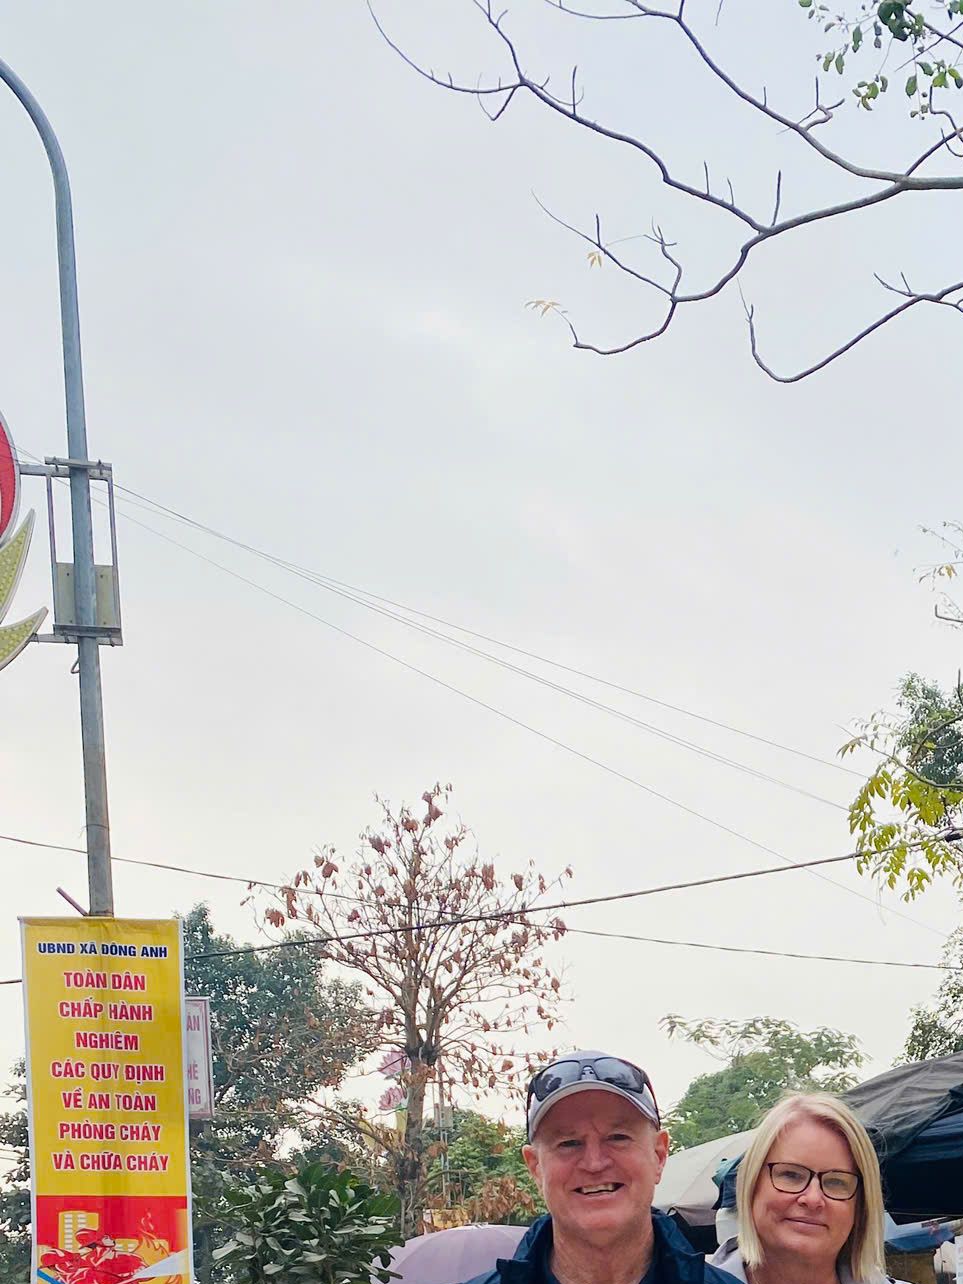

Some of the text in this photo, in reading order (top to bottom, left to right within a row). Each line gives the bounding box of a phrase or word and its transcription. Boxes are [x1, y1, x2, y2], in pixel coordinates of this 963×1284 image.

[37, 942, 75, 954] UBND
[79, 941, 98, 955] XÃ
[140, 946, 168, 958] ANH
[63, 968, 146, 991] TOÀN DÂN
[59, 996, 153, 1021] CHẤP HÀNH
[75, 1031, 139, 1051] NGHIÊM
[51, 1058, 164, 1084] CÁC QUY ĐỊNH
[62, 1087, 156, 1111] VỀ AN TOÀN
[59, 1119, 161, 1141] PHÒNG CHÁY
[52, 1150, 169, 1171] VÀ CHỮA CHÁY
